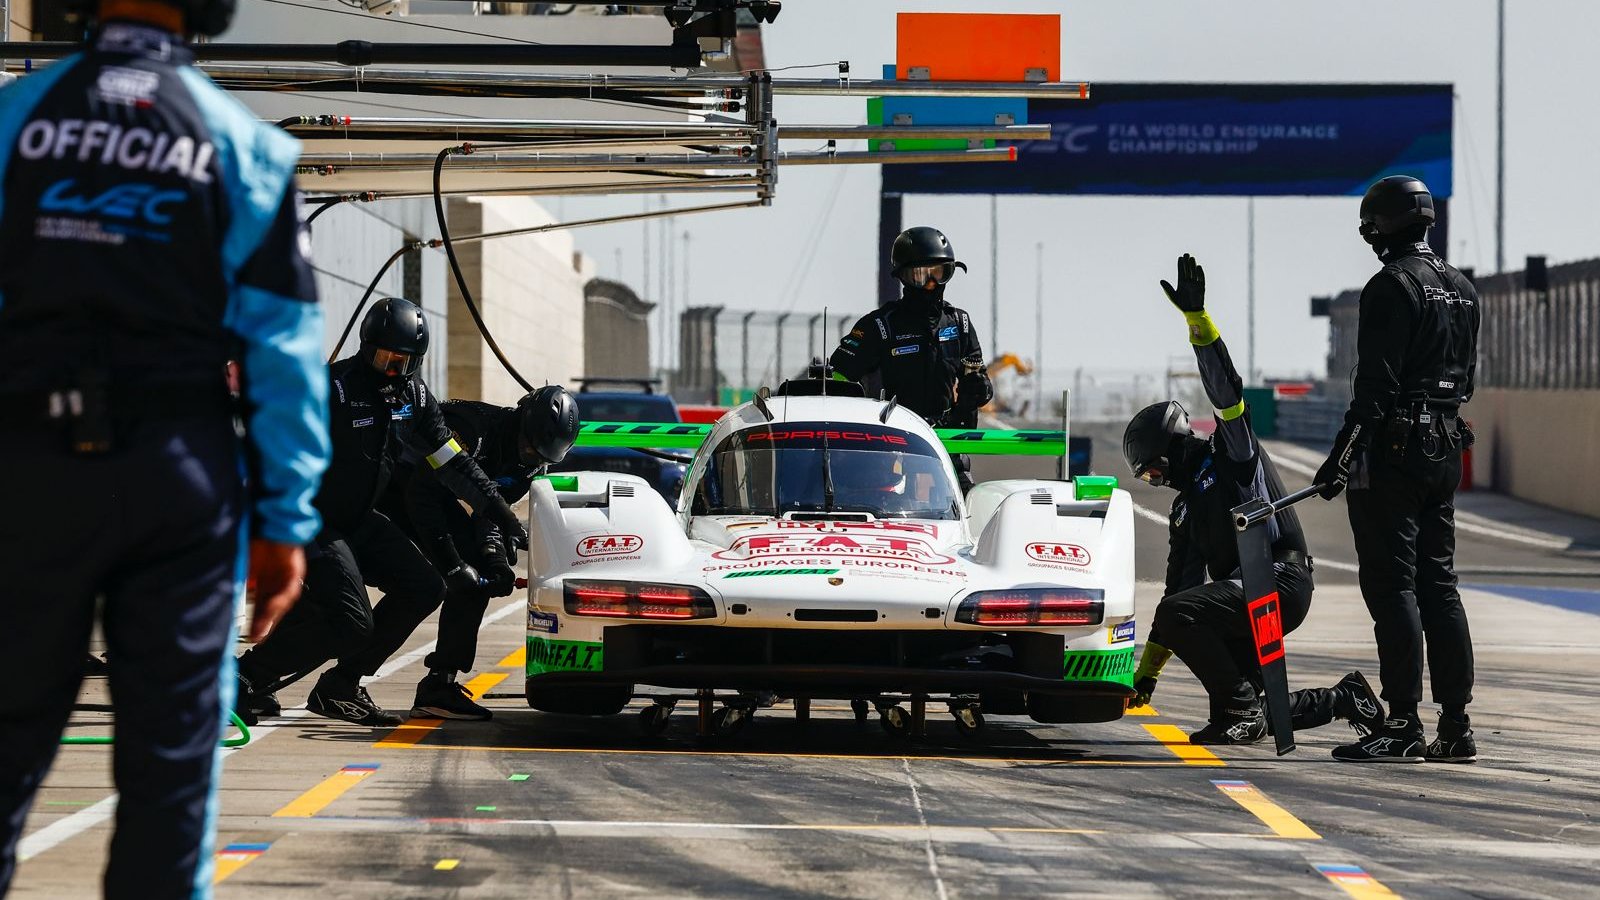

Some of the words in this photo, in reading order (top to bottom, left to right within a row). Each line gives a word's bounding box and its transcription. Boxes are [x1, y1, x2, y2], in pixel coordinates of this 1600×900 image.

[1108, 123, 1138, 138] FIA
[1145, 123, 1215, 139] WORLD
[1220, 124, 1340, 140] ENDURANCE
[18, 118, 217, 184] OFFICIAL
[1108, 139, 1259, 154] CHAMPIONSHIP
[39, 179, 189, 225] WEC
[747, 430, 908, 445] PORSCHE
[749, 546, 919, 559] INTERNATIONAL
[571, 557, 605, 566] GROUPAGES
[703, 559, 832, 572] GROUPAGES
